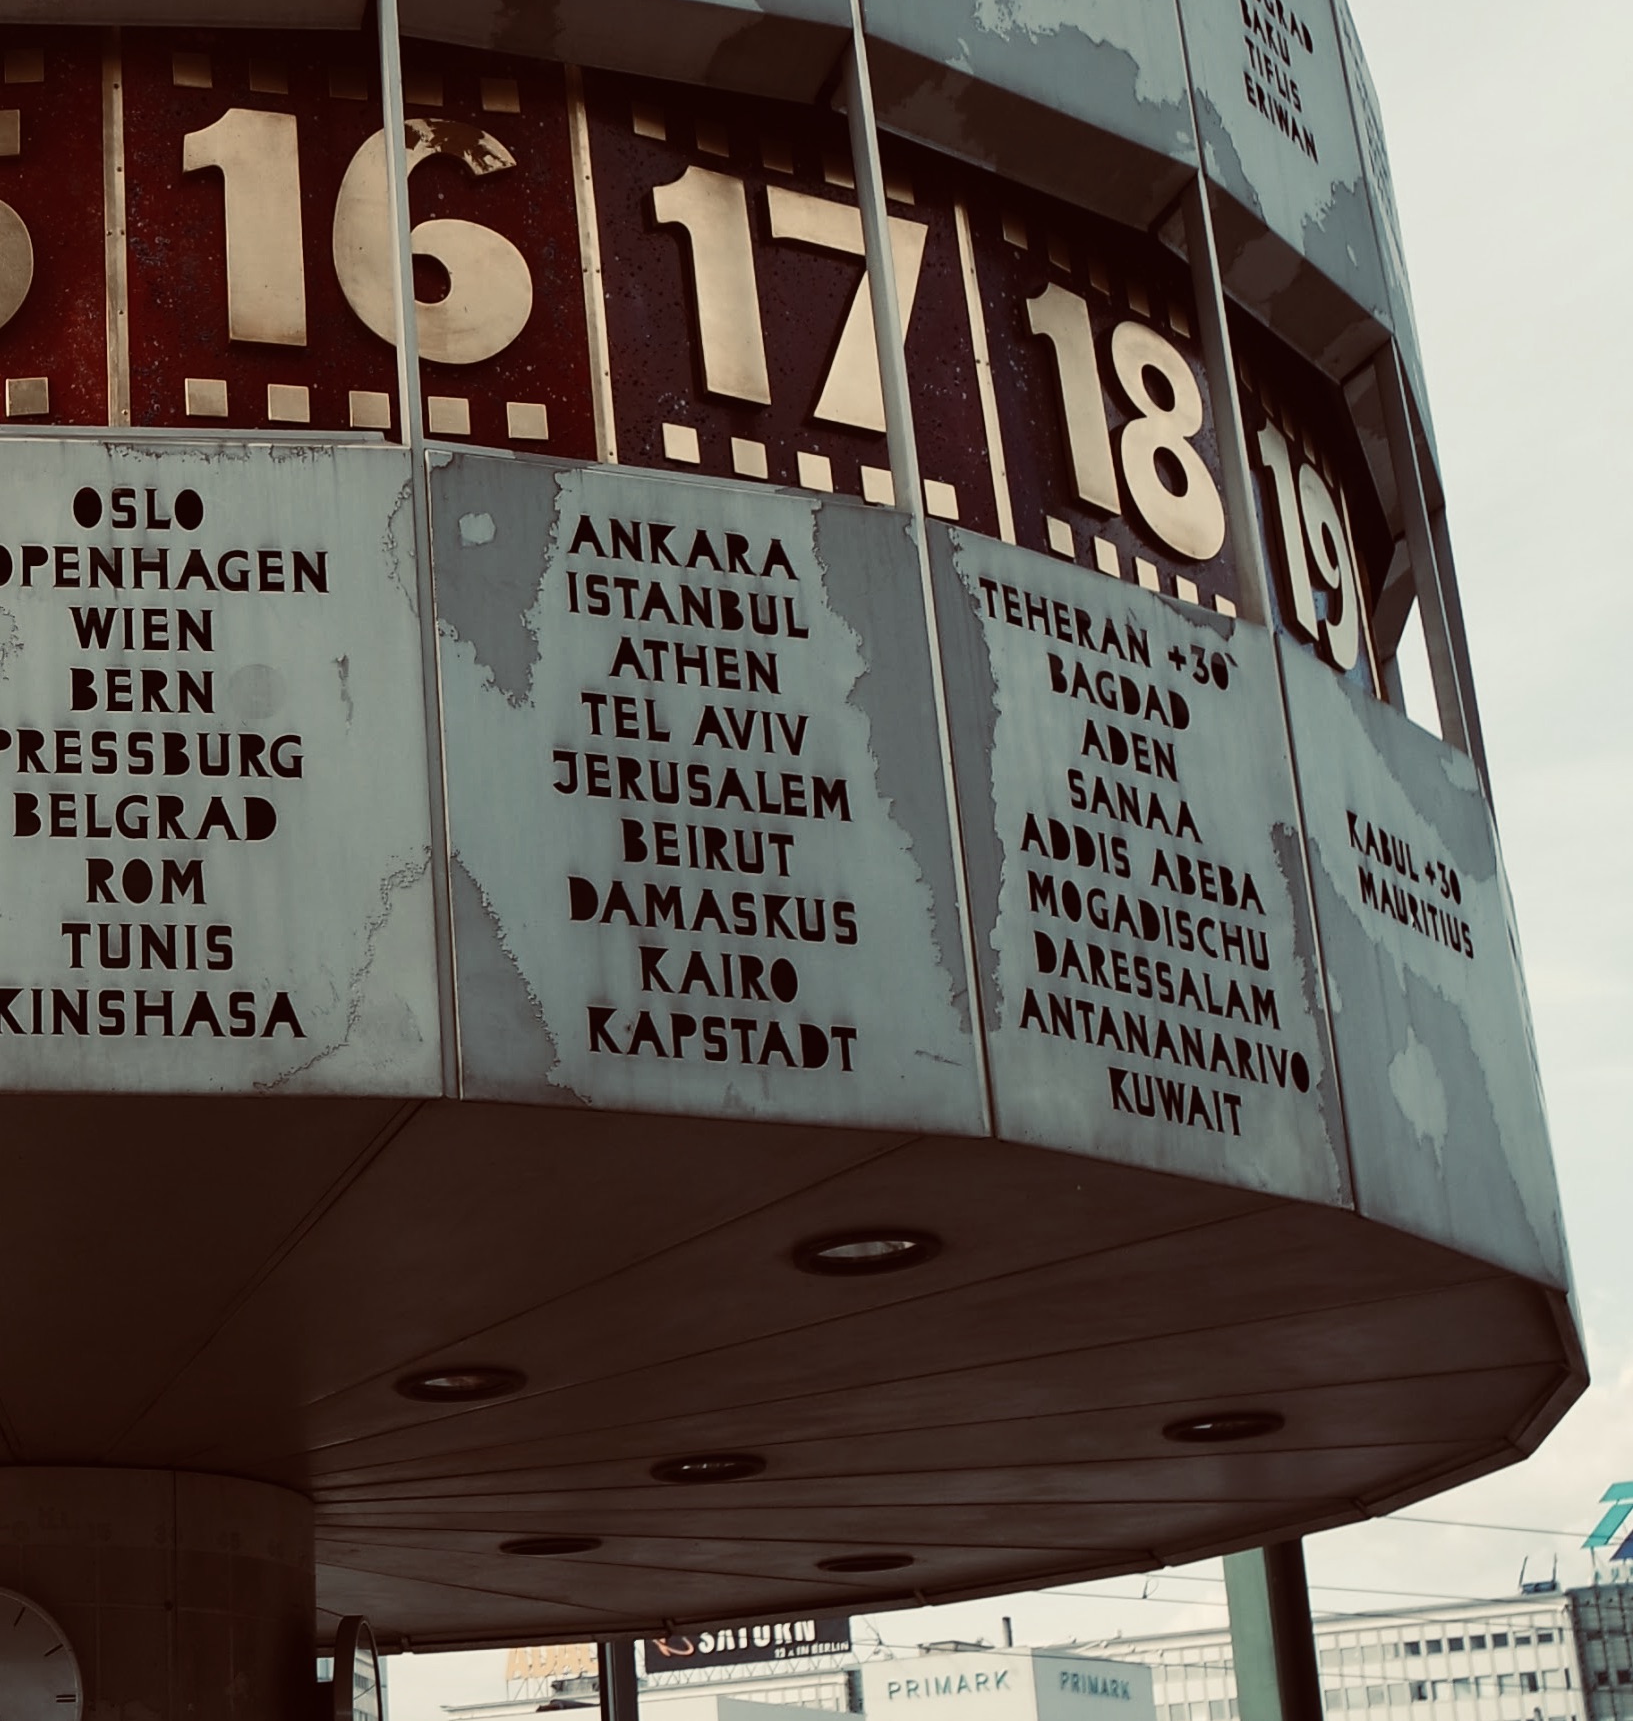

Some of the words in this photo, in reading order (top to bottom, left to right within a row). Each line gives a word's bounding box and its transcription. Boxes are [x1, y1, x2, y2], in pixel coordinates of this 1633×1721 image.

[1244, 35, 1302, 113] TIFLIS
[1243, 71, 1319, 163] ERIWAN
[183, 108, 533, 364] 16
[652, 165, 929, 433] 17
[1025, 282, 1227, 561] 18
[72, 486, 204, 531] OSLO
[566, 514, 800, 581] ANKARA
[1257, 419, 1360, 674] 19
[68, 606, 215, 652] WIEN
[565, 570, 809, 639] ISTANBUL
[978, 576, 1152, 668] TEHERAN
[69, 667, 215, 714] BERN
[608, 636, 782, 695] ATHEN
[1047, 652, 1190, 730] BAGDAD
[580, 691, 671, 743] TEL
[692, 704, 809, 757] AVIV
[1080, 718, 1179, 783] ADEN
[13, 792, 277, 841] BELGRAD
[552, 749, 853, 823] JERUSALEM
[1067, 768, 1203, 845] SANAA
[85, 857, 207, 905] ROM
[620, 817, 795, 878] BEIRUT
[1020, 812, 1131, 879] ADDIS
[1150, 848, 1267, 916] ABEBA
[1346, 809, 1420, 883] KABUL
[1424, 860, 1462, 906] +30
[567, 875, 858, 946] DAMASKUS
[1027, 869, 1270, 972] MOGADISCHU
[1358, 865, 1474, 960] MAURITIUS
[61, 922, 233, 971] TUNIS
[637, 945, 799, 1004] KAIRO
[1033, 929, 1281, 1031] DARESSALAM
[586, 1005, 858, 1072] KAPSTADT
[1018, 987, 1310, 1094] ANTANANARIVO
[1107, 1066, 1242, 1137] KUWAIT
[887, 1669, 1011, 1700] PRIMARK
[1059, 1670, 1131, 1701] PRIMARK
